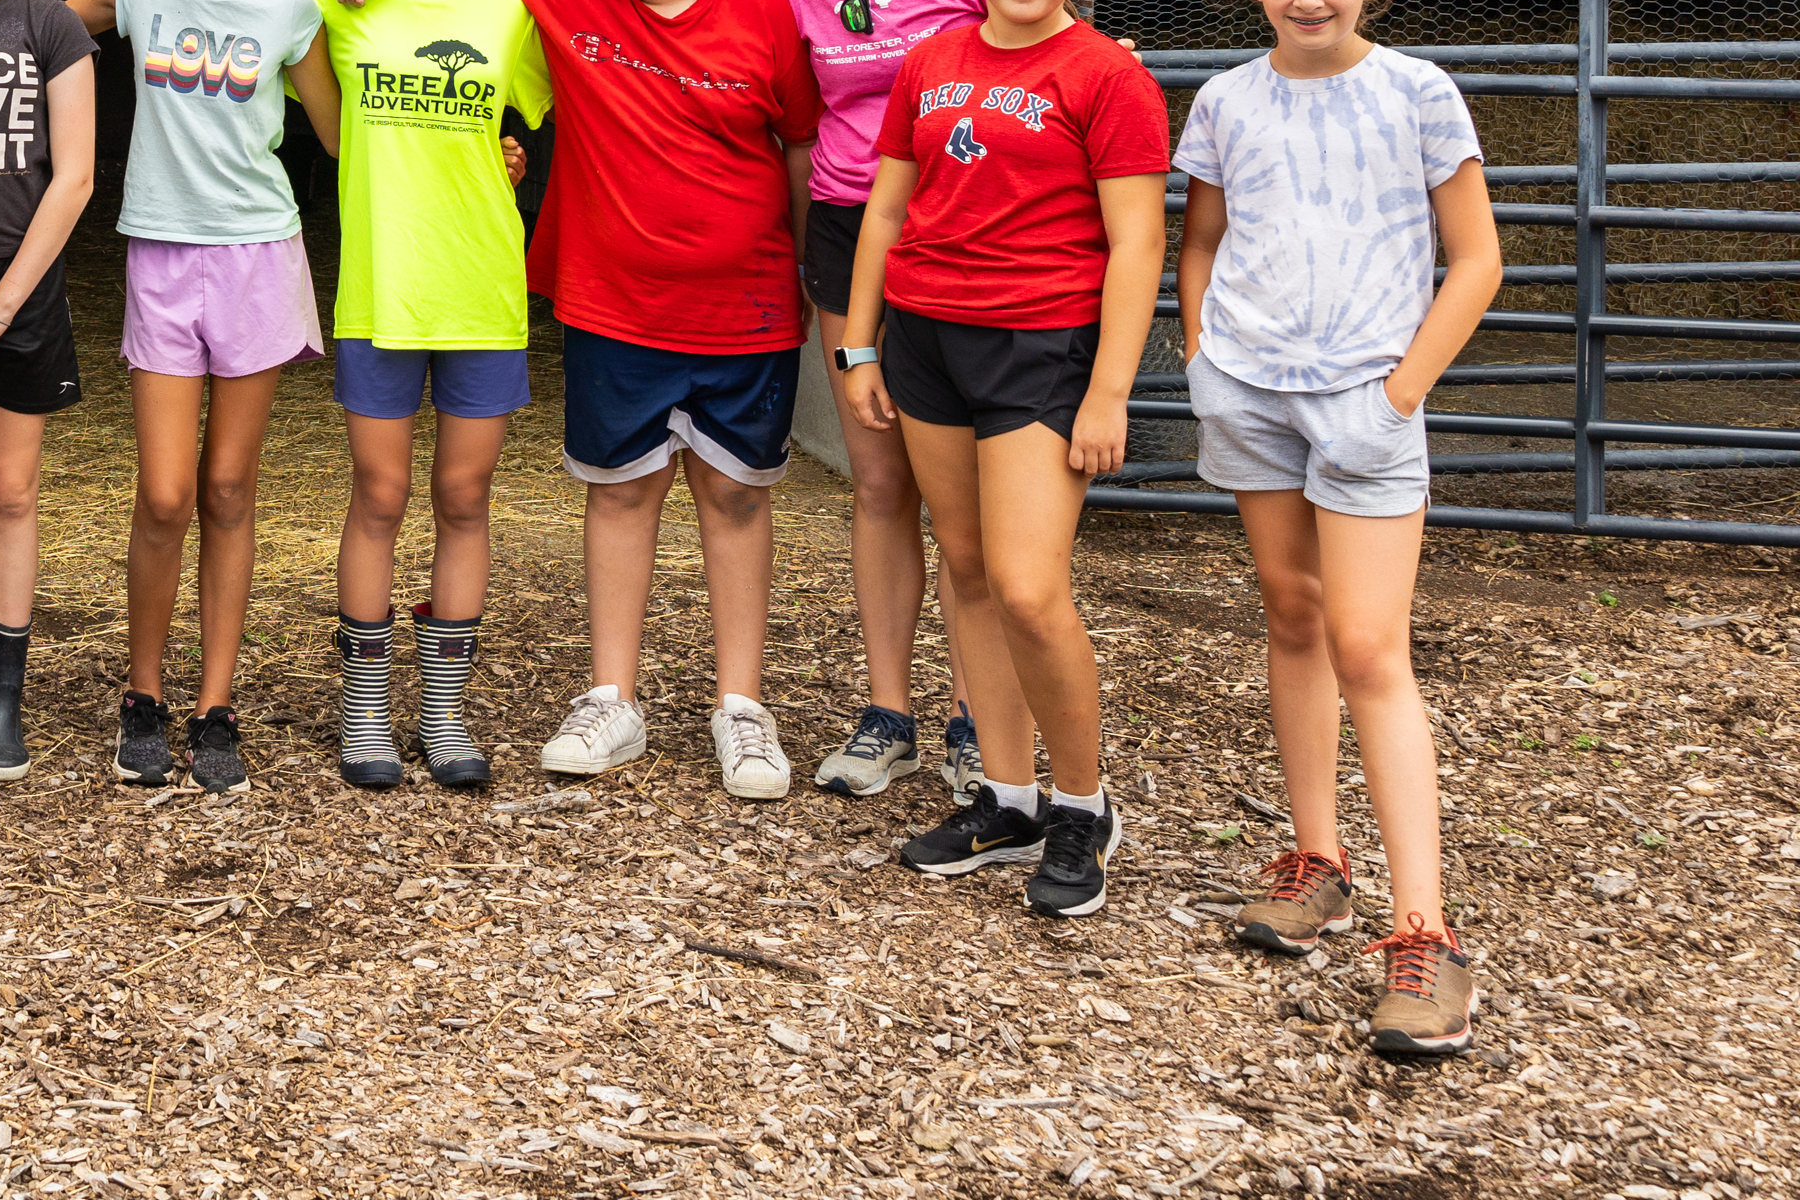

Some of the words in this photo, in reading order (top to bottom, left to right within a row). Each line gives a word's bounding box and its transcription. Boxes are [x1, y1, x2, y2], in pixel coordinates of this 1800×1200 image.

[145, 13, 262, 90] Love
[846, 37, 906, 53] FORESTER,
[825, 56, 857, 65] POWISSET
[858, 54, 877, 62] FARM
[360, 92, 494, 120] ADVENTURES
[920, 81, 974, 119] RED
[980, 86, 1053, 127] SOX
[392, 120, 425, 130] CULTURAL
[426, 123, 452, 132] CENTRE
